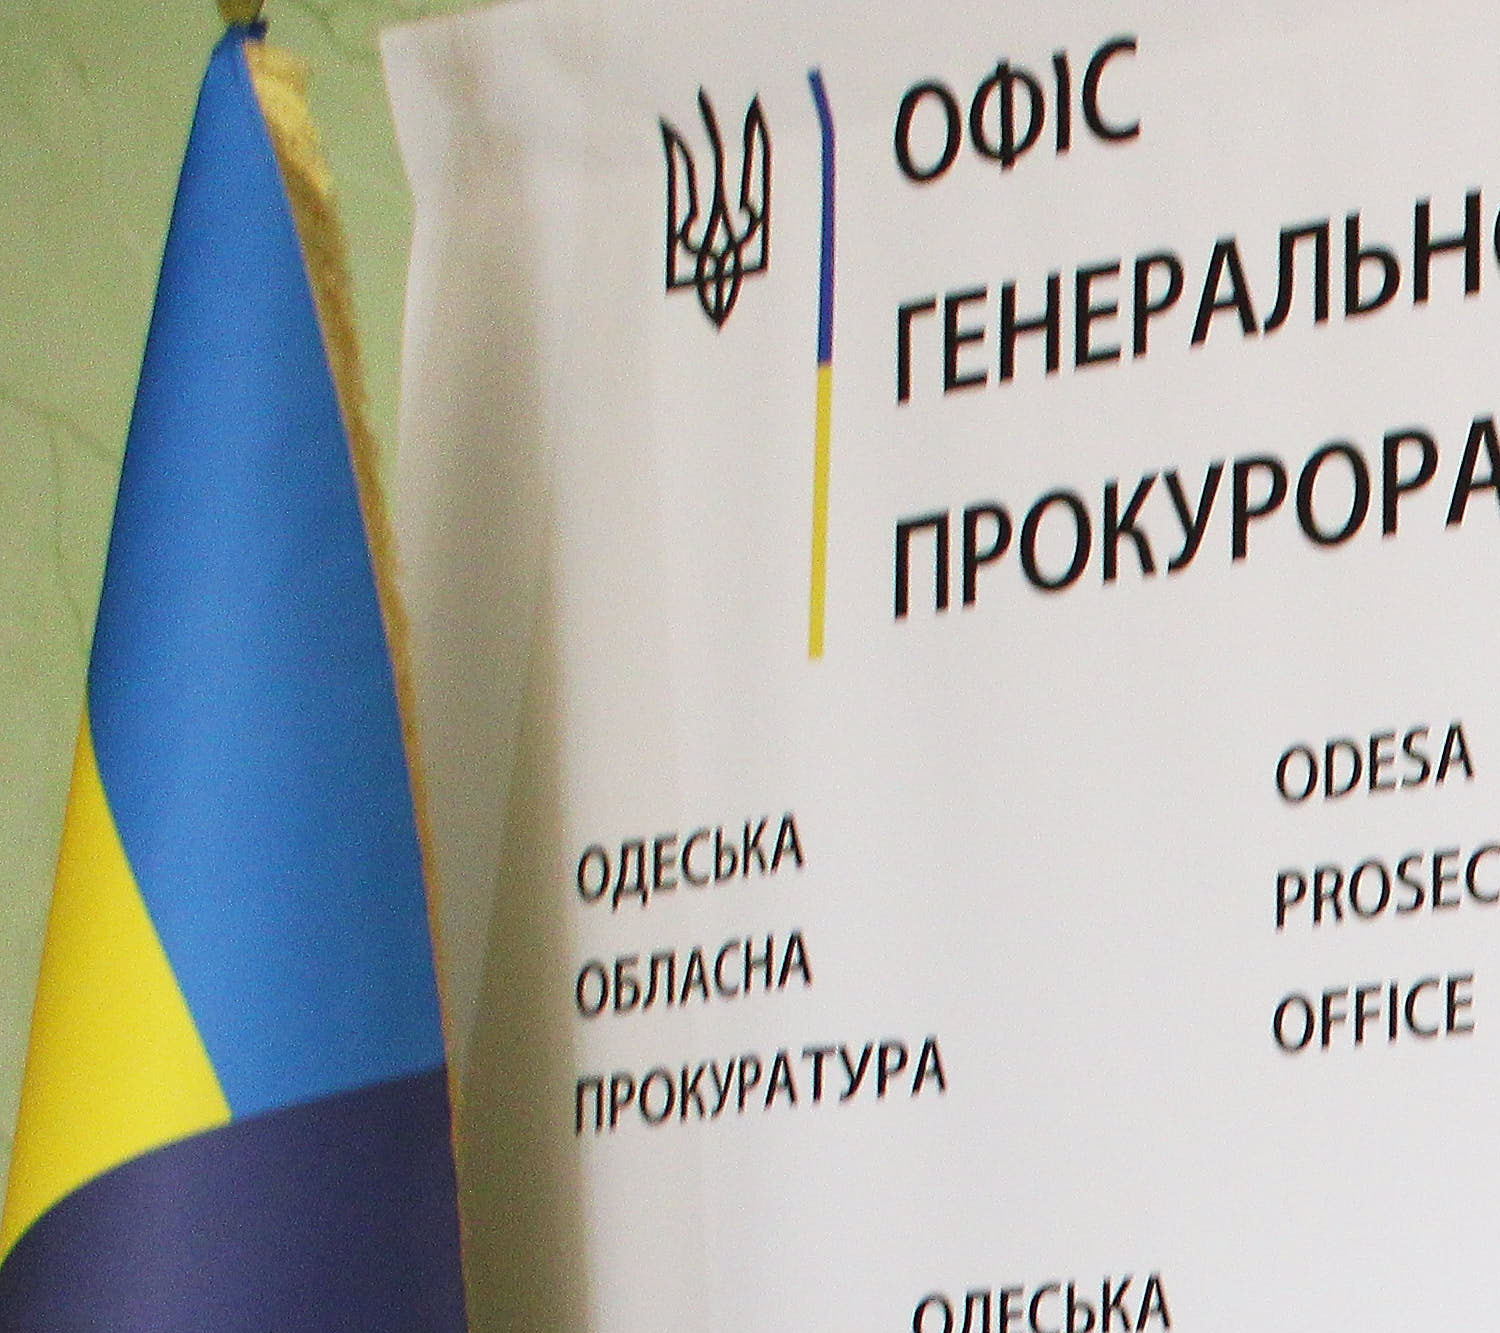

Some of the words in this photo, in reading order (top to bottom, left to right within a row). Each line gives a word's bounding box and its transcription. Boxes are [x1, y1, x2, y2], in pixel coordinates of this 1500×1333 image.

[892, 34, 1142, 187] ОФІС
[1274, 721, 1475, 805] ODESA
[575, 813, 805, 913] ОДЕСЬКА
[574, 930, 813, 1020] ОБЛАСНА
[1271, 973, 1475, 1055] OFFICE
[574, 1036, 948, 1137] ПРОКУРАТУРА
